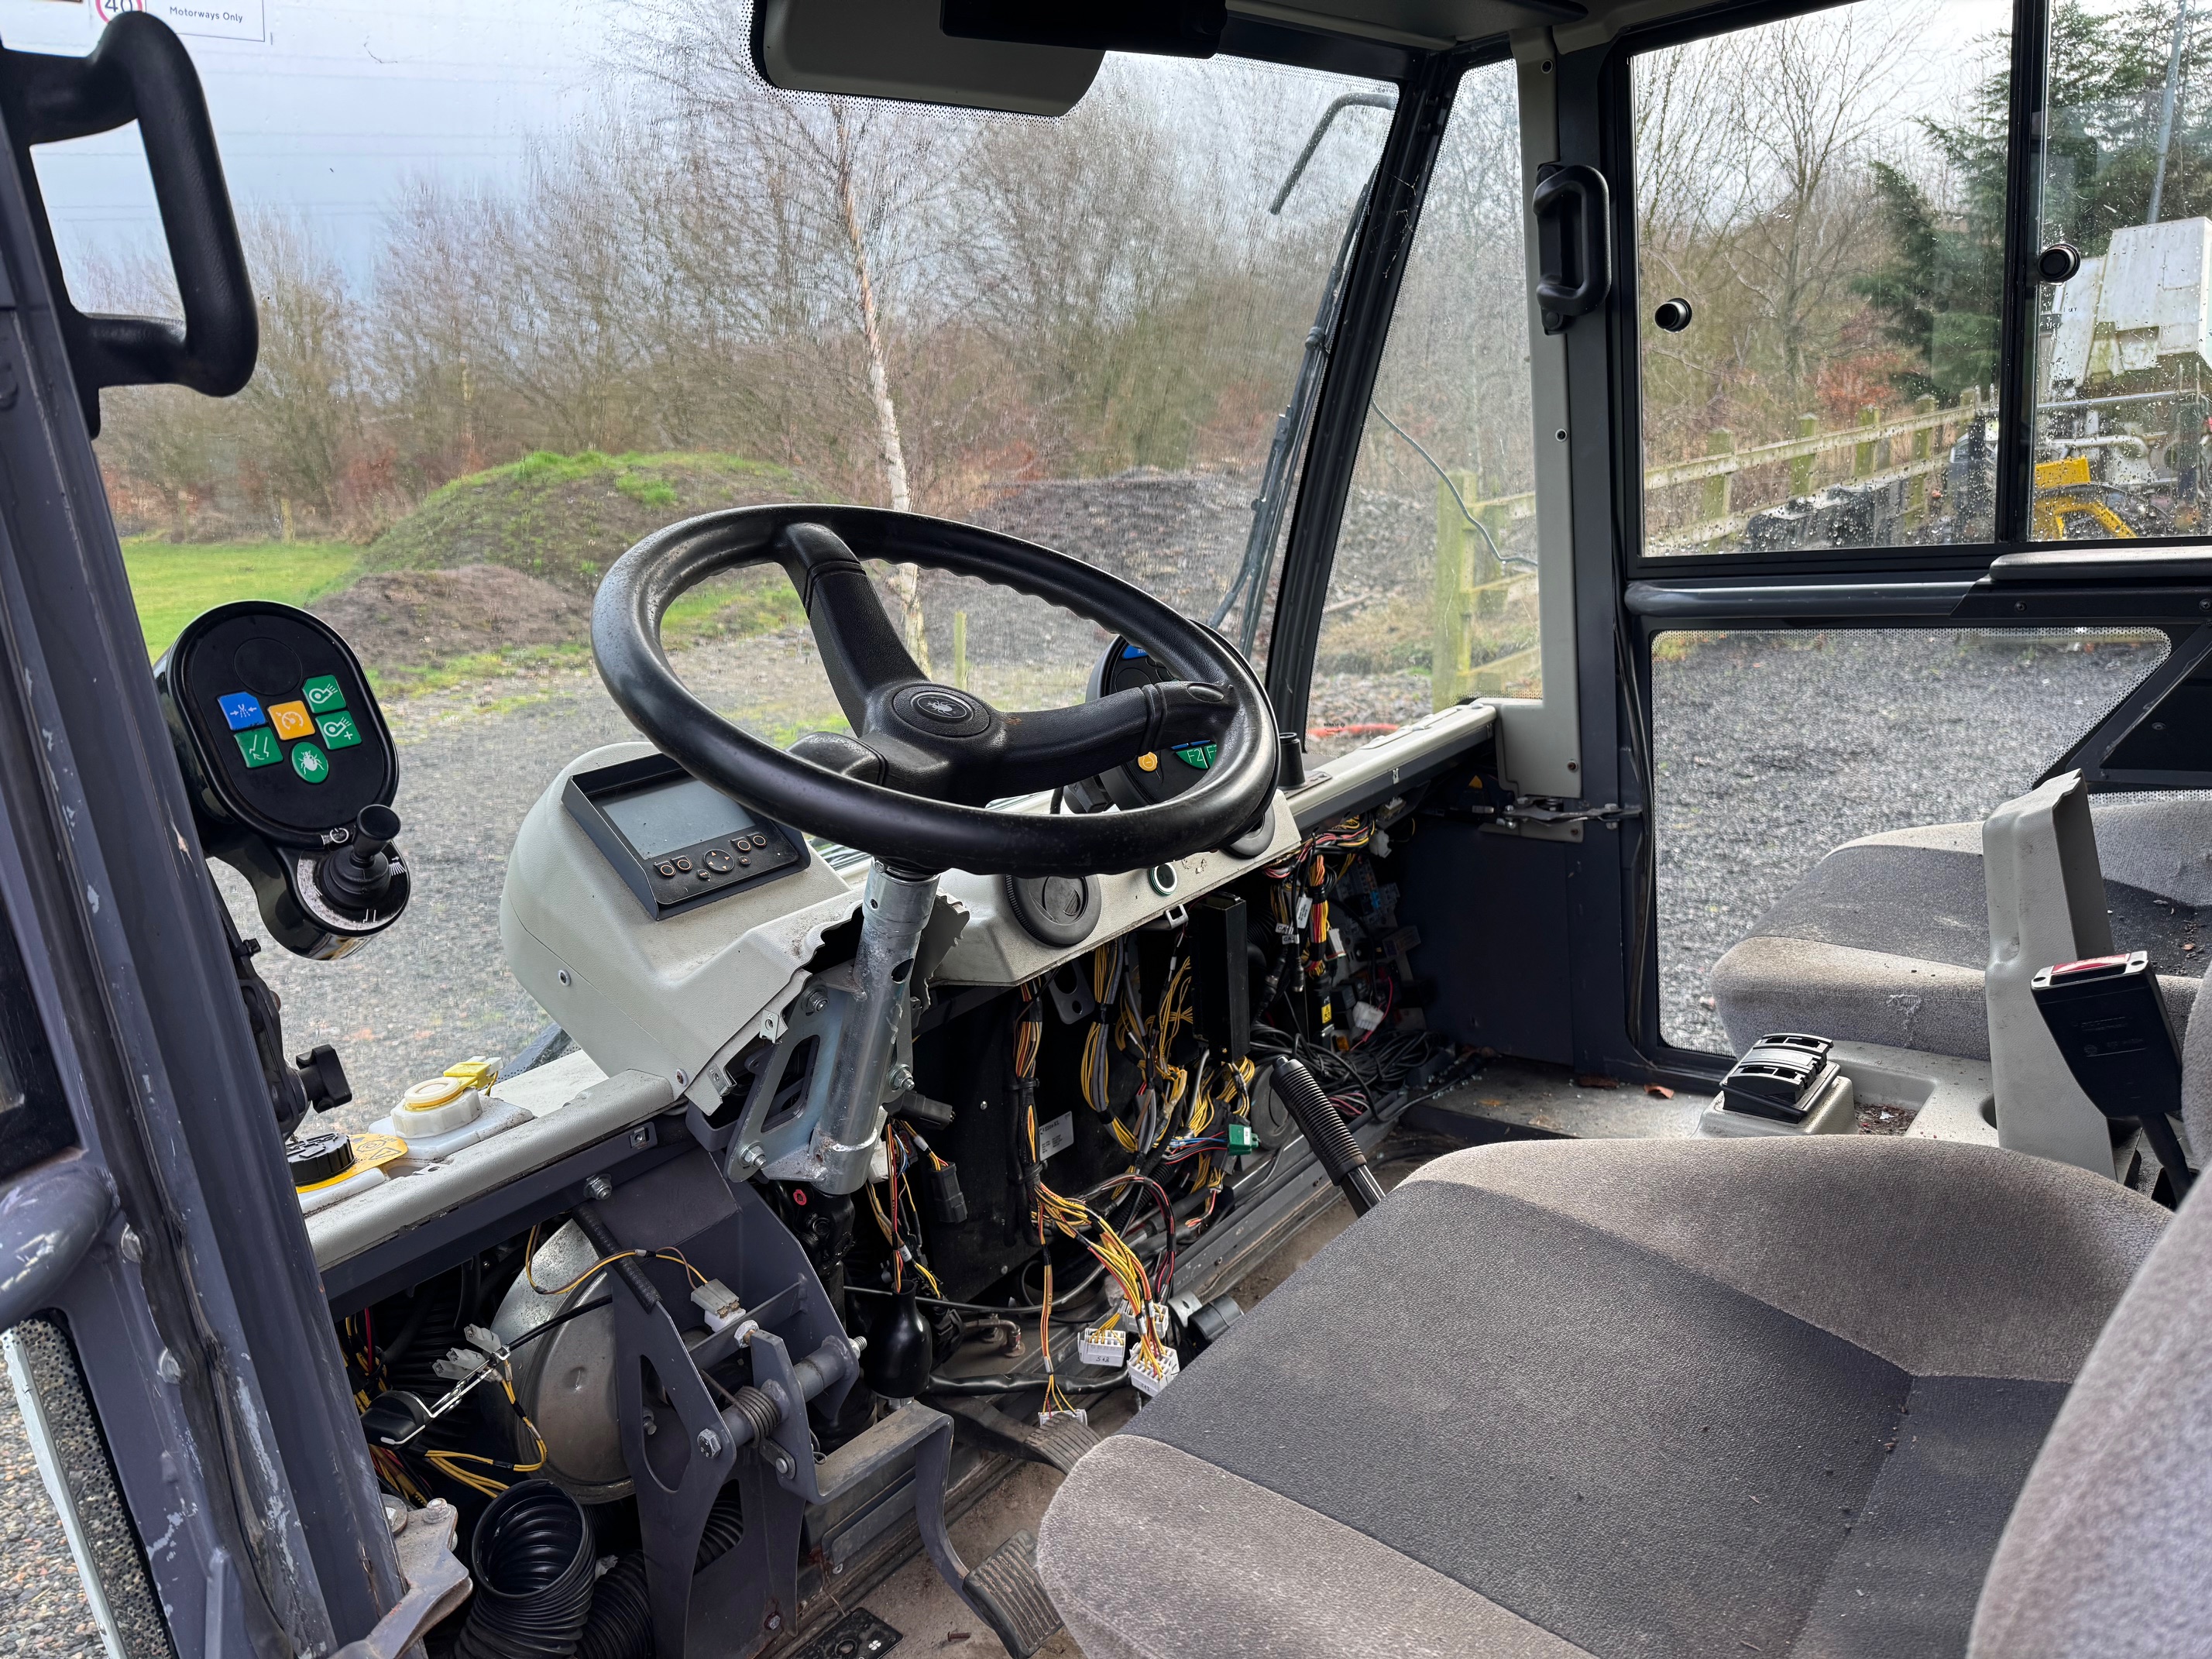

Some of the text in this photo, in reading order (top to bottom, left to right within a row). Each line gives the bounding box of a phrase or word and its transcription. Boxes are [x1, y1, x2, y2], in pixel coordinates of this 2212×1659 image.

[105, 0, 132, 12] 40
[170, 6, 243, 23] Motorways Only
[1187, 748, 1204, 764] F2
